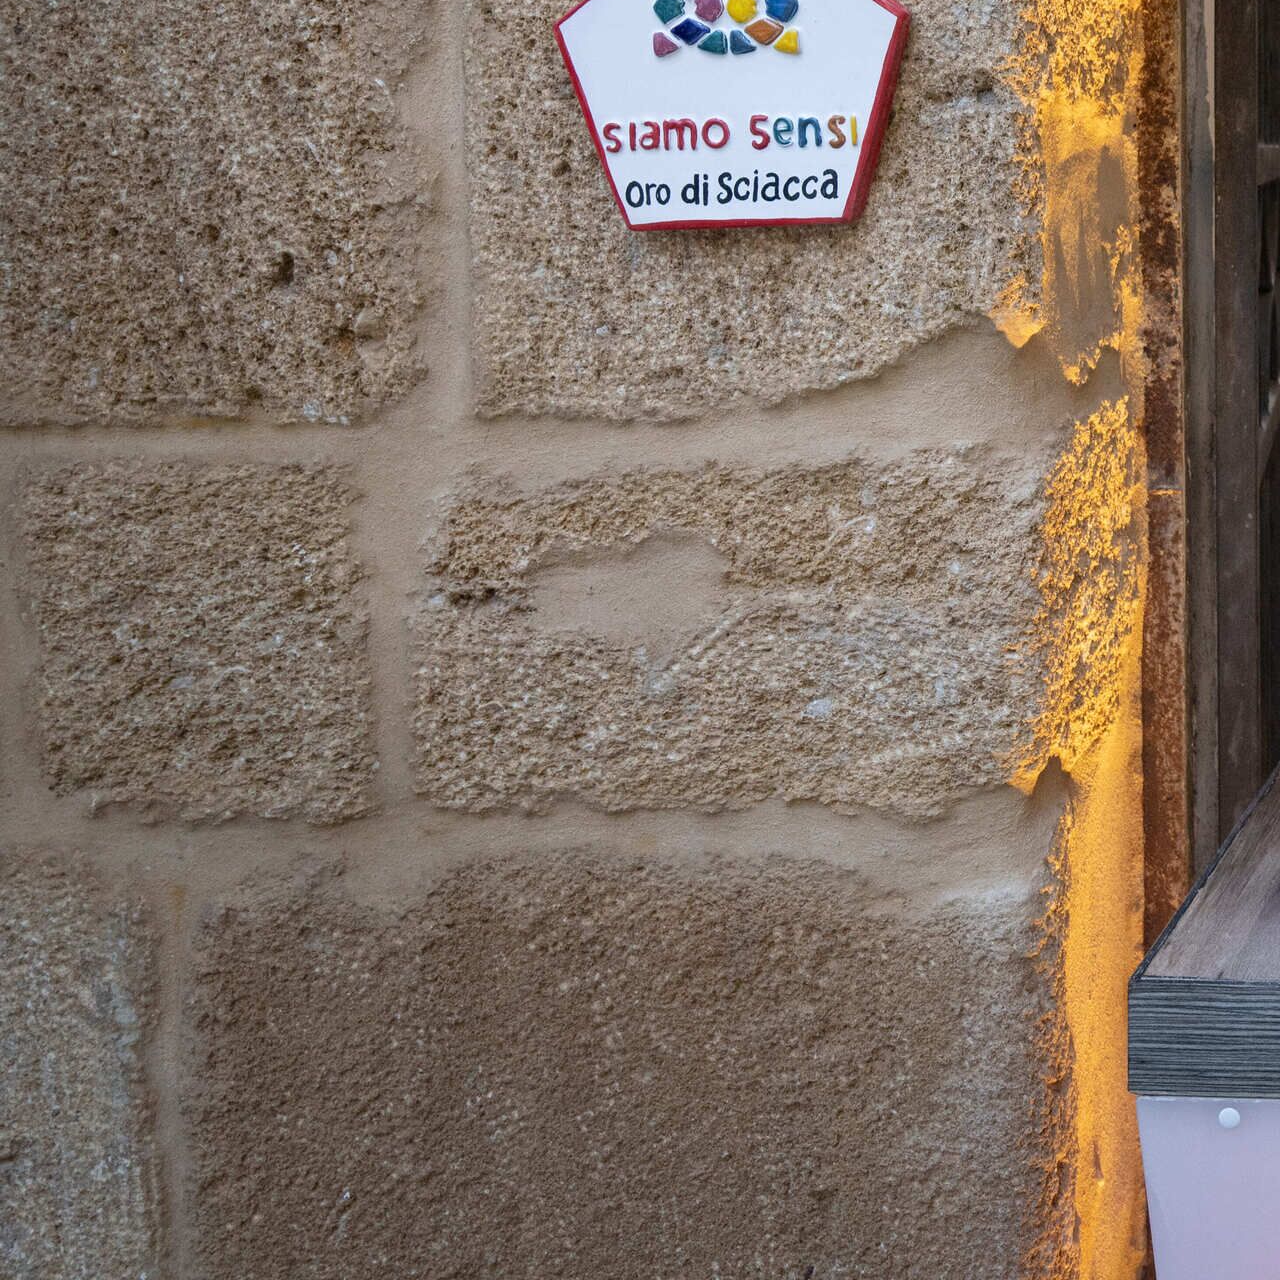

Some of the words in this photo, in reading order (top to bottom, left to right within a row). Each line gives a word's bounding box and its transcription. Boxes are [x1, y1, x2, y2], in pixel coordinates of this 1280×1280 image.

[602, 117, 731, 153] siamo
[680, 173, 709, 206] di
[716, 168, 839, 205] Sciacca
